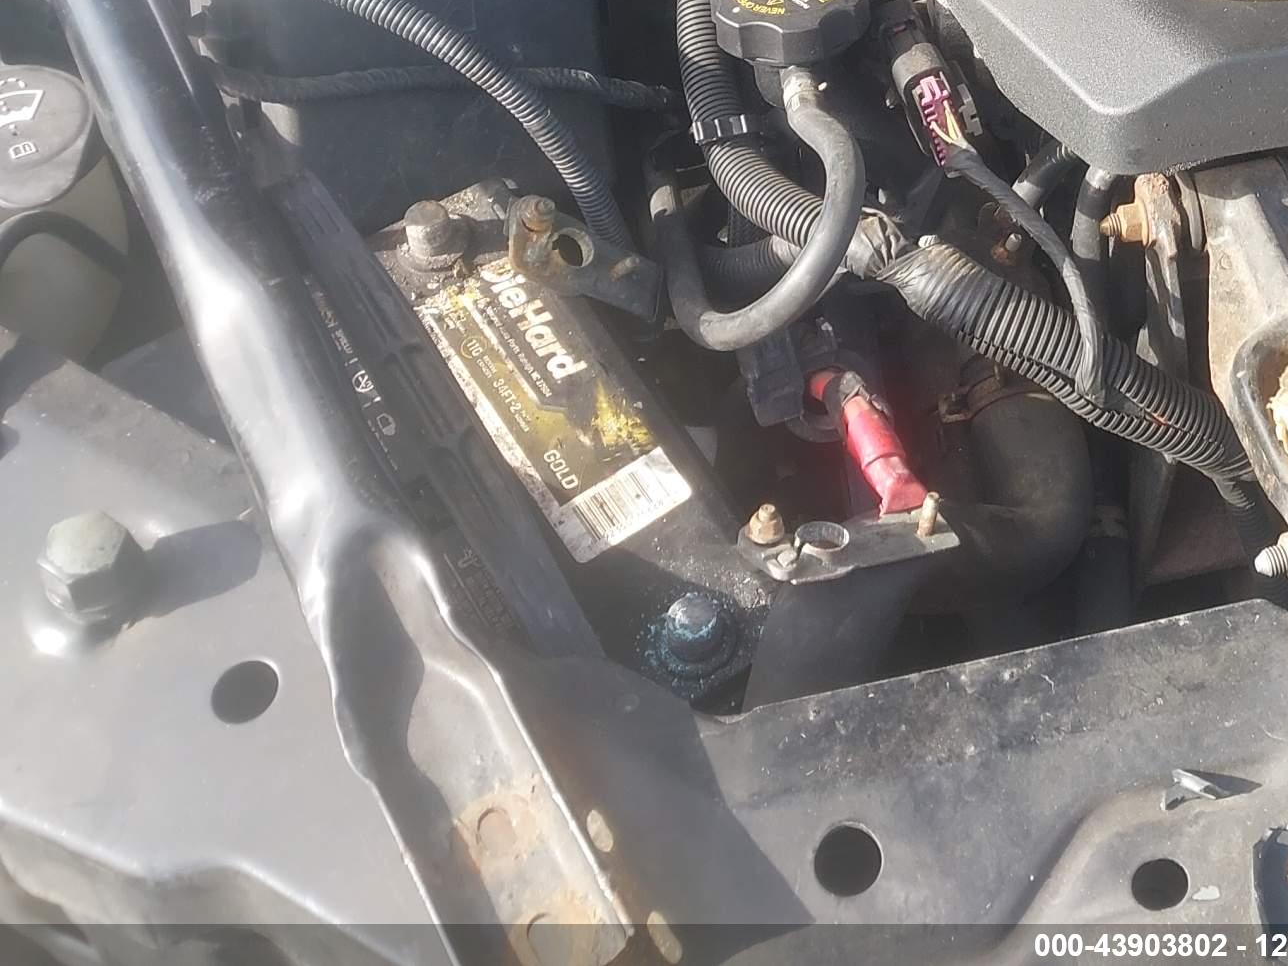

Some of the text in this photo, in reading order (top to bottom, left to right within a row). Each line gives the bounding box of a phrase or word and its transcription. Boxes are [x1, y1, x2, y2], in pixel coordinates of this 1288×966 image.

[752, 4, 786, 14] NEVER
[479, 265, 588, 381] DieHard
[466, 336, 483, 358] 110
[543, 449, 579, 490] GOLD
